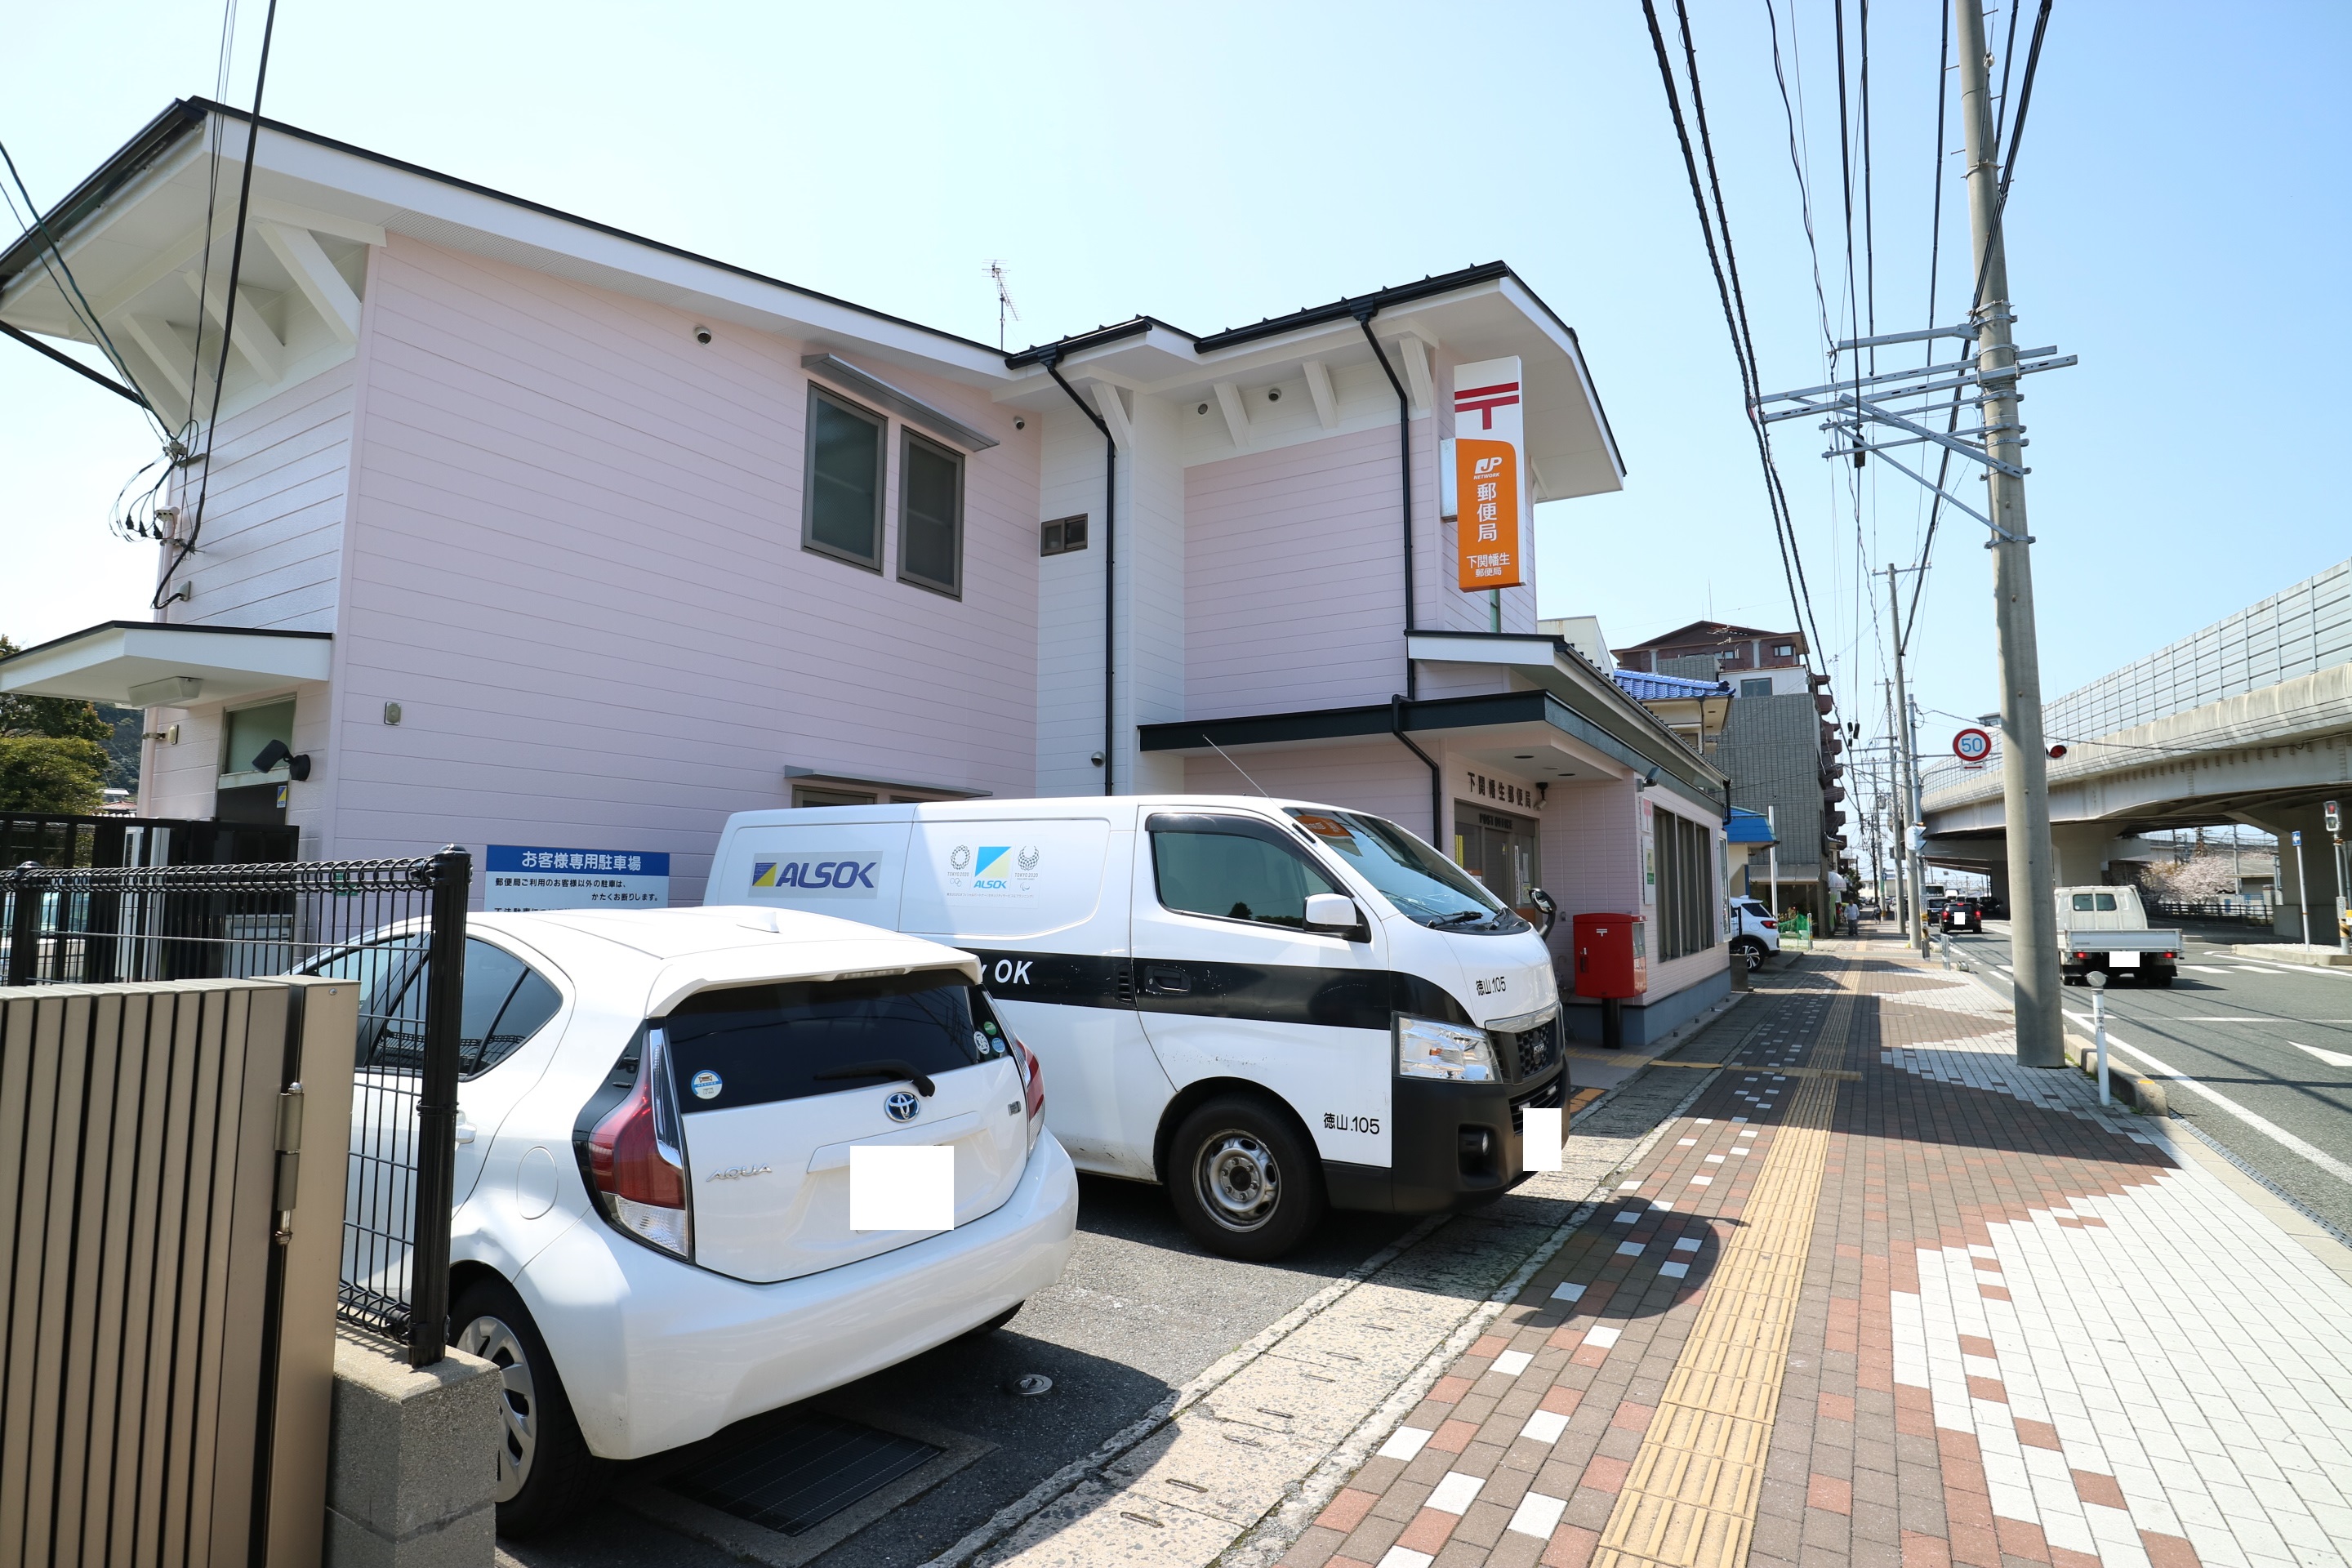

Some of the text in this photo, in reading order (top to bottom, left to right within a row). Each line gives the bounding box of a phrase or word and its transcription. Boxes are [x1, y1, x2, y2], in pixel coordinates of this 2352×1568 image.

[1475, 457, 1502, 474] JP
[1473, 472, 1500, 480] NETWORK
[1477, 483, 1498, 542] 郵便局
[1466, 552, 1510, 569] 下関幡生
[1475, 567, 1502, 577] 郵便局
[1962, 737, 1983, 753] 50
[1467, 771, 1531, 809] 下関幡生郵便局
[521, 850, 641, 871] お客様専用駐車場
[495, 877, 626, 889] 郵便局ご利用のお客様以外の駐車は、
[776, 861, 878, 889] ALSOK
[973, 880, 1007, 889] ALSOK
[591, 893, 658, 902] かたくお断りします。
[995, 959, 1033, 985] OK
[706, 1163, 773, 1182] AQUA
